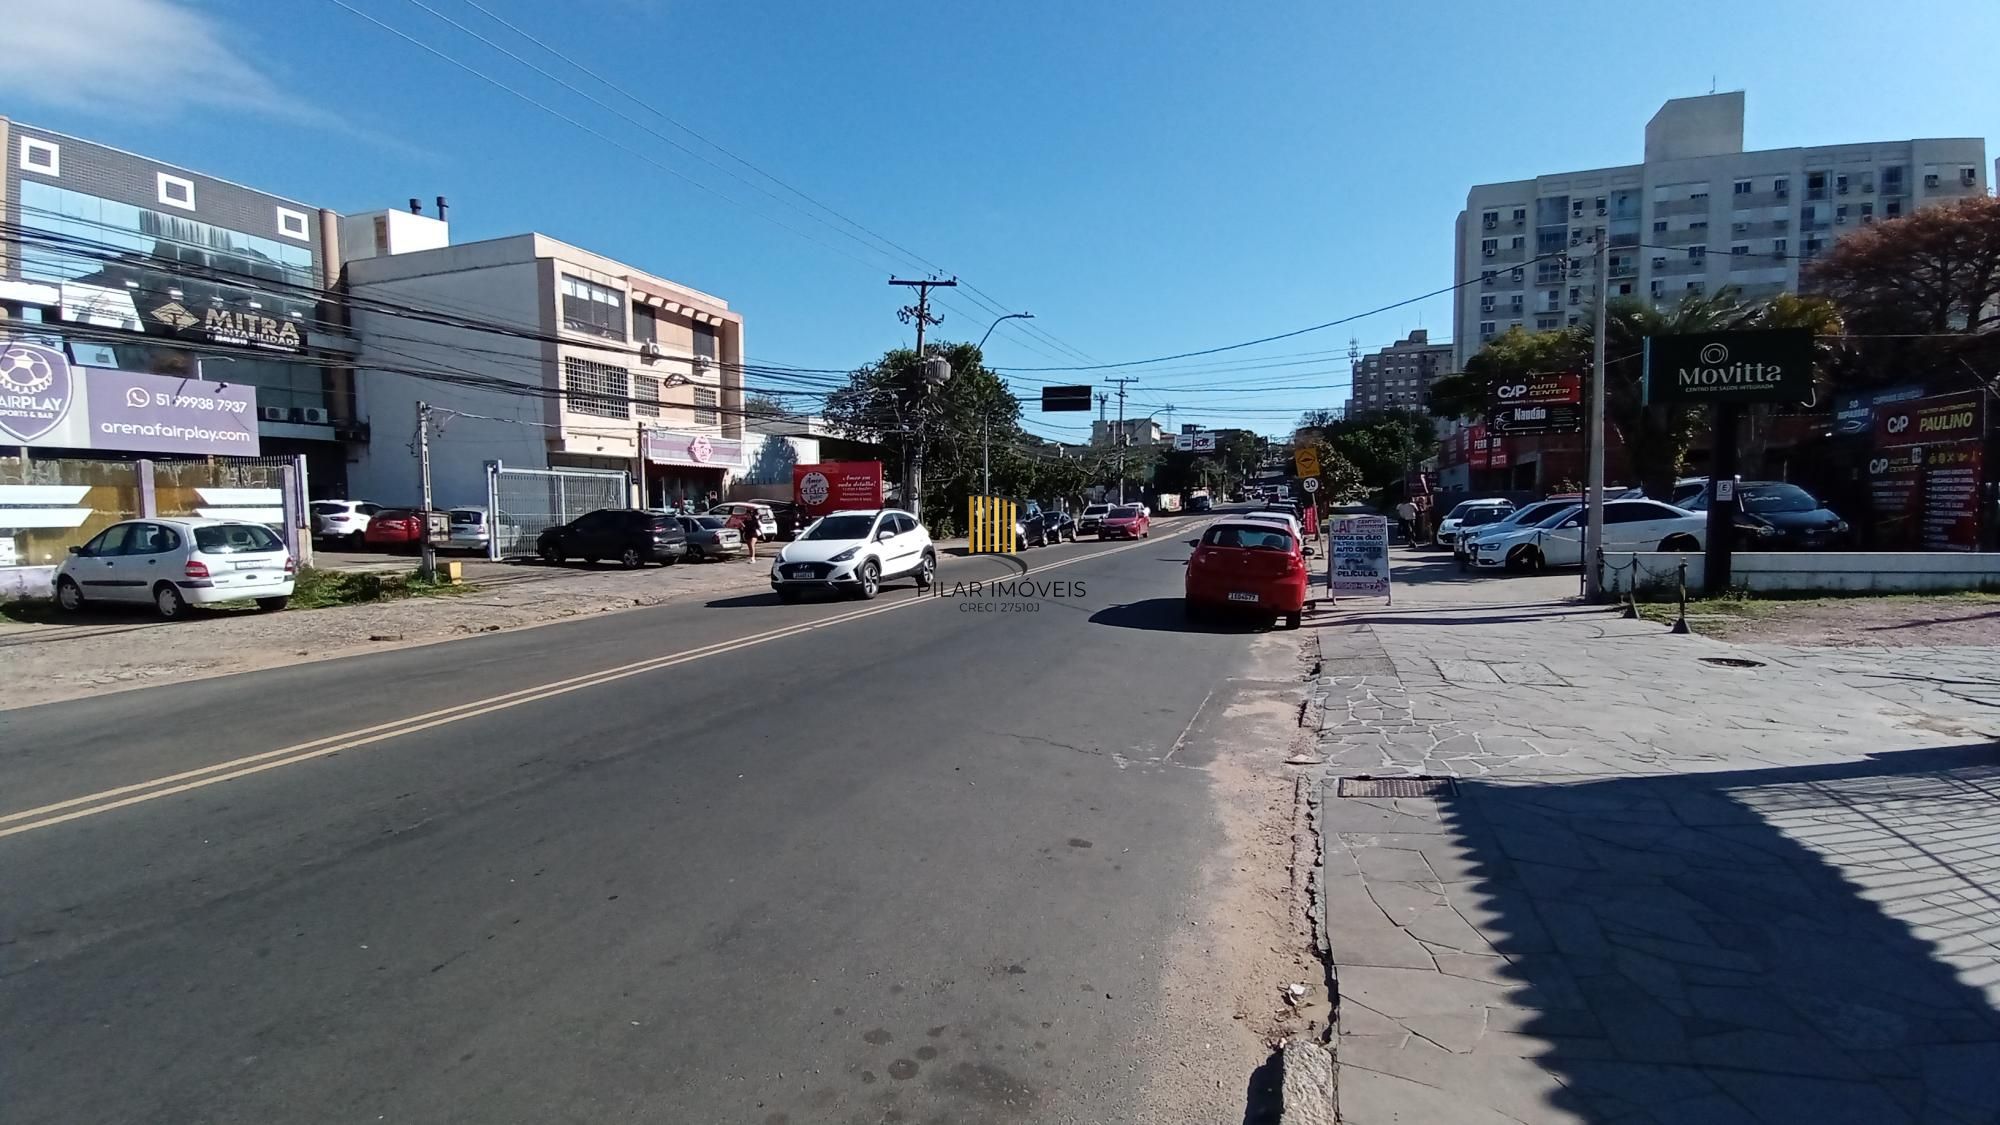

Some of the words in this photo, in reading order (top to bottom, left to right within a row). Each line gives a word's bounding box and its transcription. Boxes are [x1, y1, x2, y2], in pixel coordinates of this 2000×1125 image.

[205, 308, 300, 340] MITRA
[205, 325, 300, 347] CONTABILIDADE
[1679, 361, 1782, 386] Movitta
[1529, 388, 1571, 396] CENTER
[0, 395, 62, 411] AIRPLAY
[156, 393, 170, 406] 51
[174, 394, 214, 411] 99938
[217, 399, 248, 414] 7937
[101, 421, 250, 443] arenafairplay.com
[1919, 411, 1973, 432] PAULINO
[1305, 479, 1316, 488] 30
